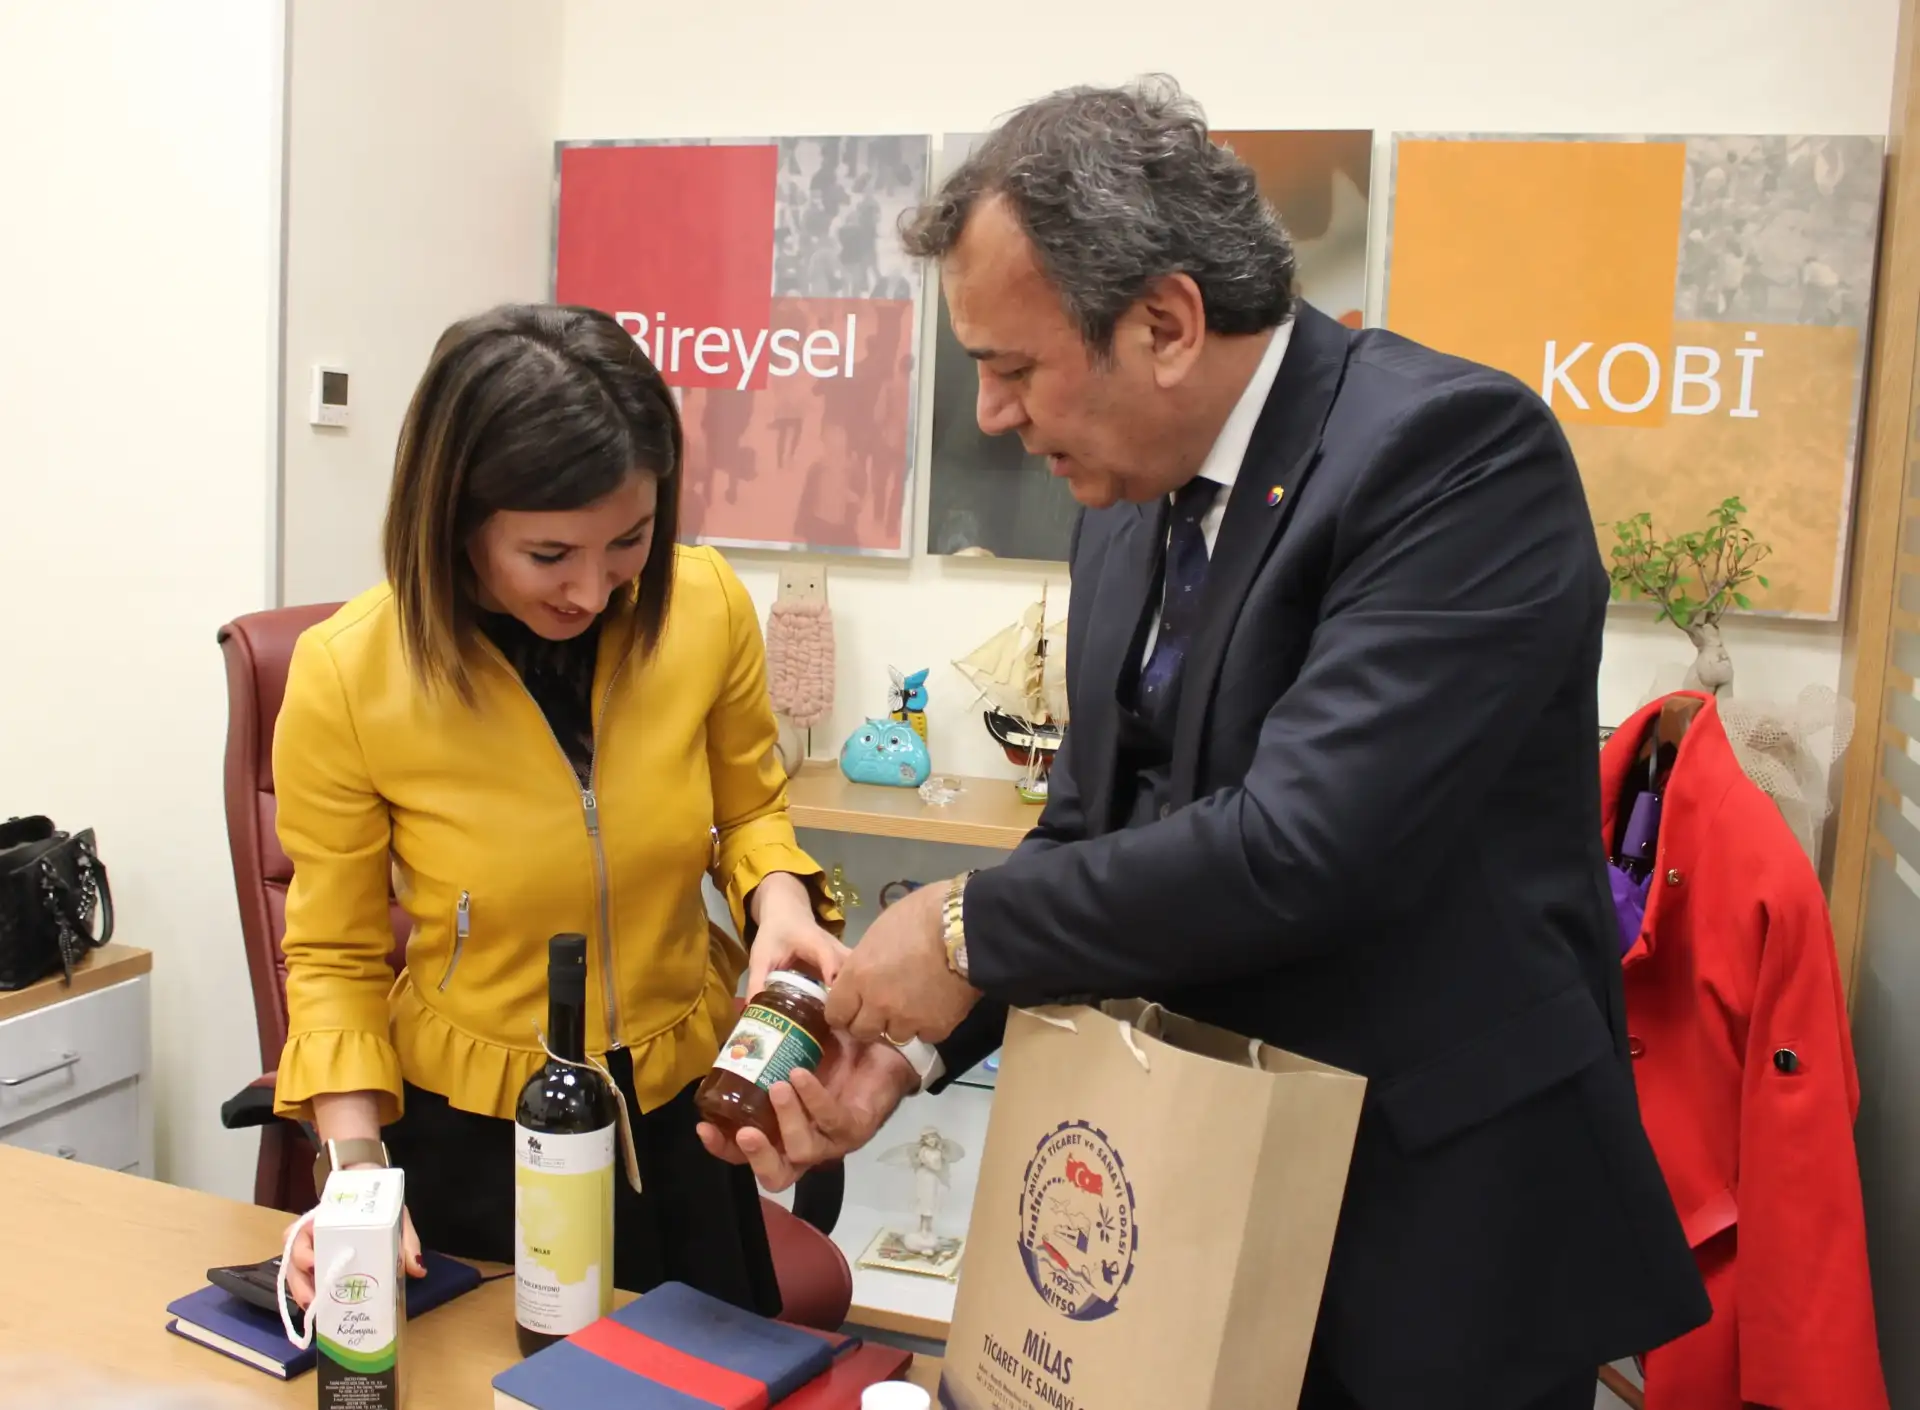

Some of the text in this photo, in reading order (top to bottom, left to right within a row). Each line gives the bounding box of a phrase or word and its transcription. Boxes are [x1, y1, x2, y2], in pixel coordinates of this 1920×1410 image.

[614, 311, 857, 391] Bireysel
[1541, 331, 1764, 418] KOBİ
[1028, 1134, 1128, 1256] MİLAS TİCARET ve SANAYİ ODASI
[1041, 1282, 1077, 1316] MİTSO
[1050, 1271, 1076, 1295] 1923
[983, 1333, 1019, 1378] TİCARET
[1020, 1365, 1034, 1390] VE
[1022, 1328, 1074, 1385] MİLAS
